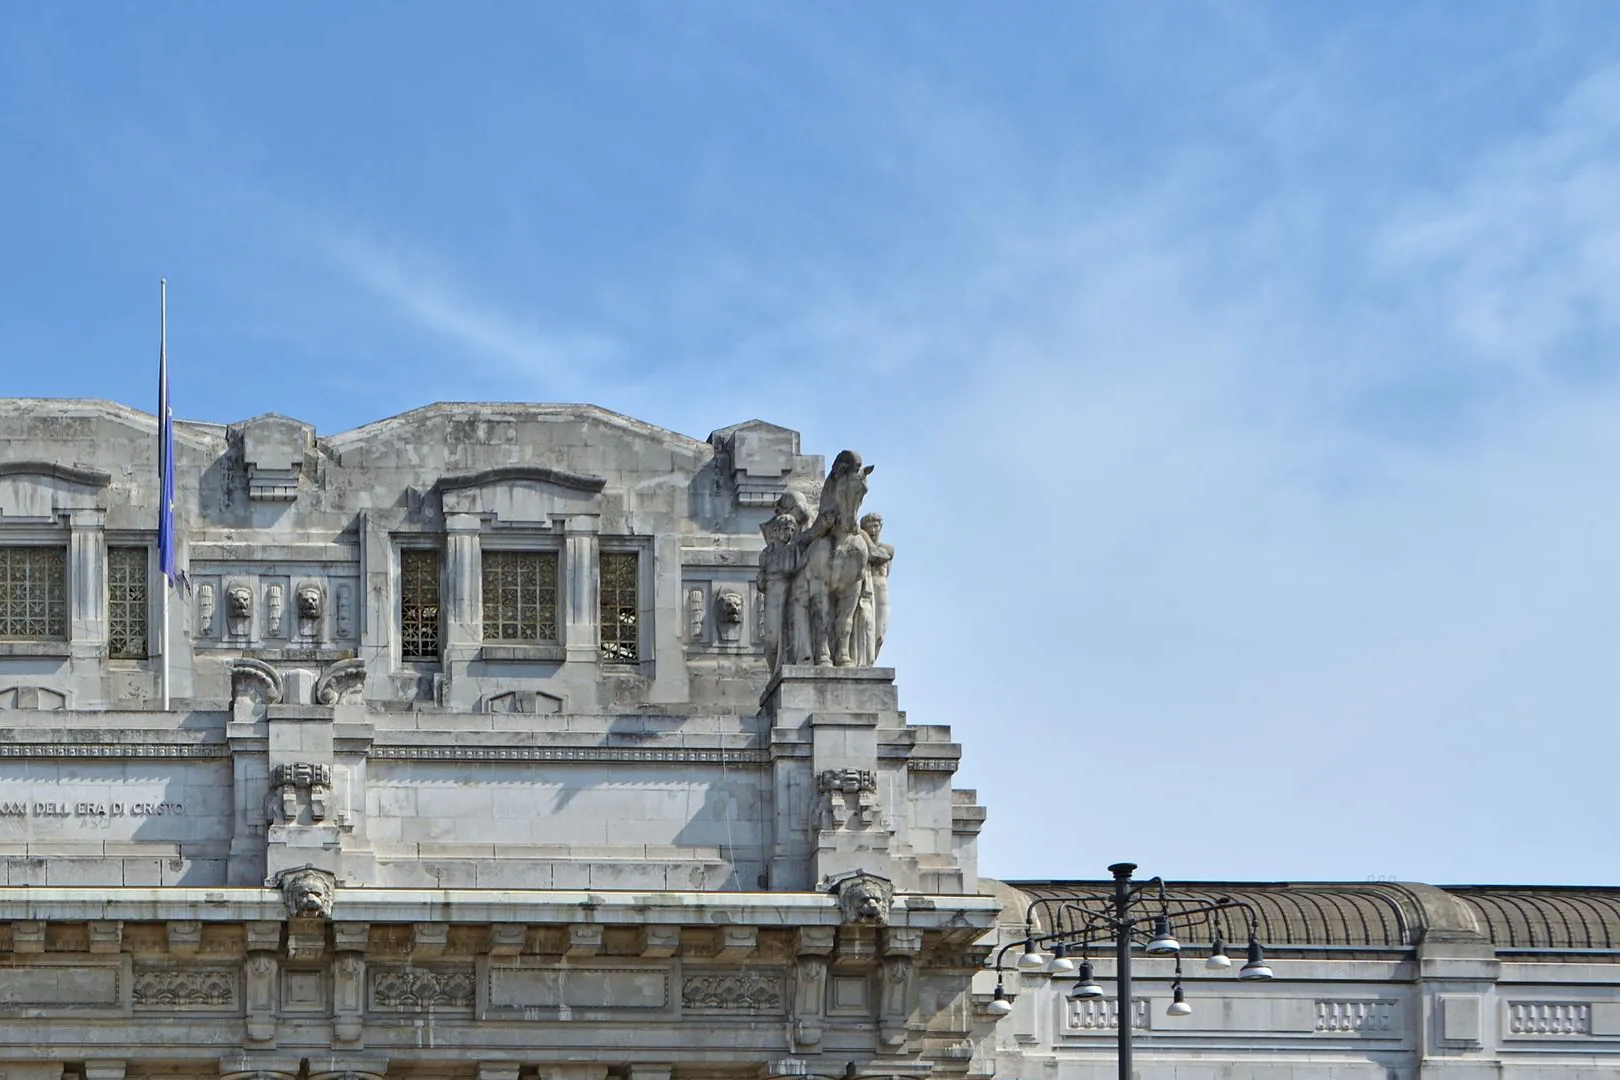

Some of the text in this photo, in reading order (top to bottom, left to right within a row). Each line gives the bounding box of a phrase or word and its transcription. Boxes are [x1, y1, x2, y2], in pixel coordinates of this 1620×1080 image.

[75, 802, 106, 817] ERA
[109, 802, 126, 817] DI
[130, 803, 184, 817] CRISTO
